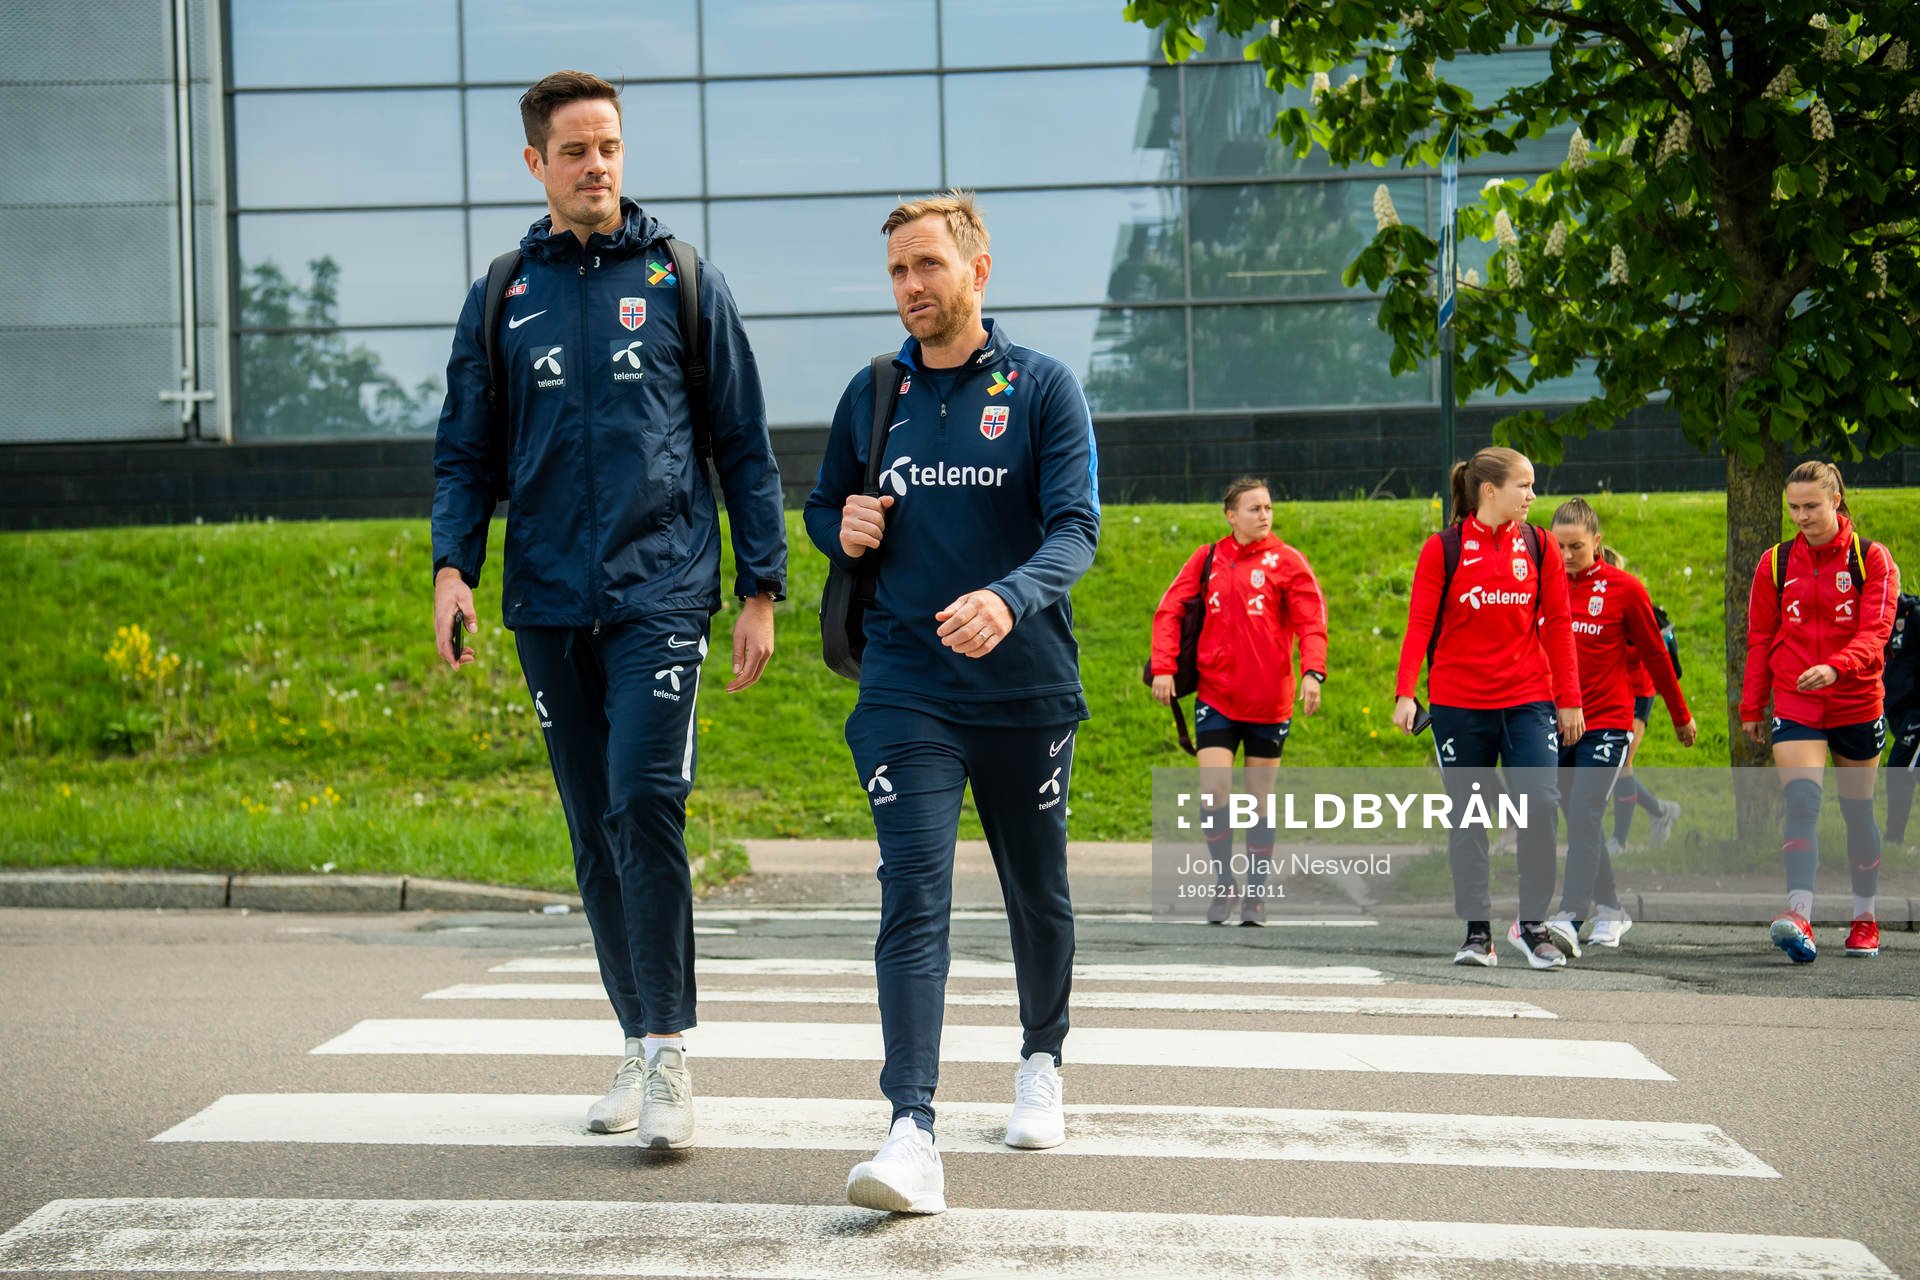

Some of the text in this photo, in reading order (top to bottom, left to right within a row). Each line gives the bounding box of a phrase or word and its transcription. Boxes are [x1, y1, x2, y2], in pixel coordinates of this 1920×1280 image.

[594, 256, 600, 268] 3
[614, 371, 643, 380] telenor
[538, 377, 564, 388] telenor
[909, 462, 1008, 487] telenor
[1481, 589, 1531, 604] telenor
[1572, 620, 1602, 635] enor
[653, 689, 680, 701] telenor
[874, 793, 897, 805] telenor
[1039, 796, 1060, 810] telenor
